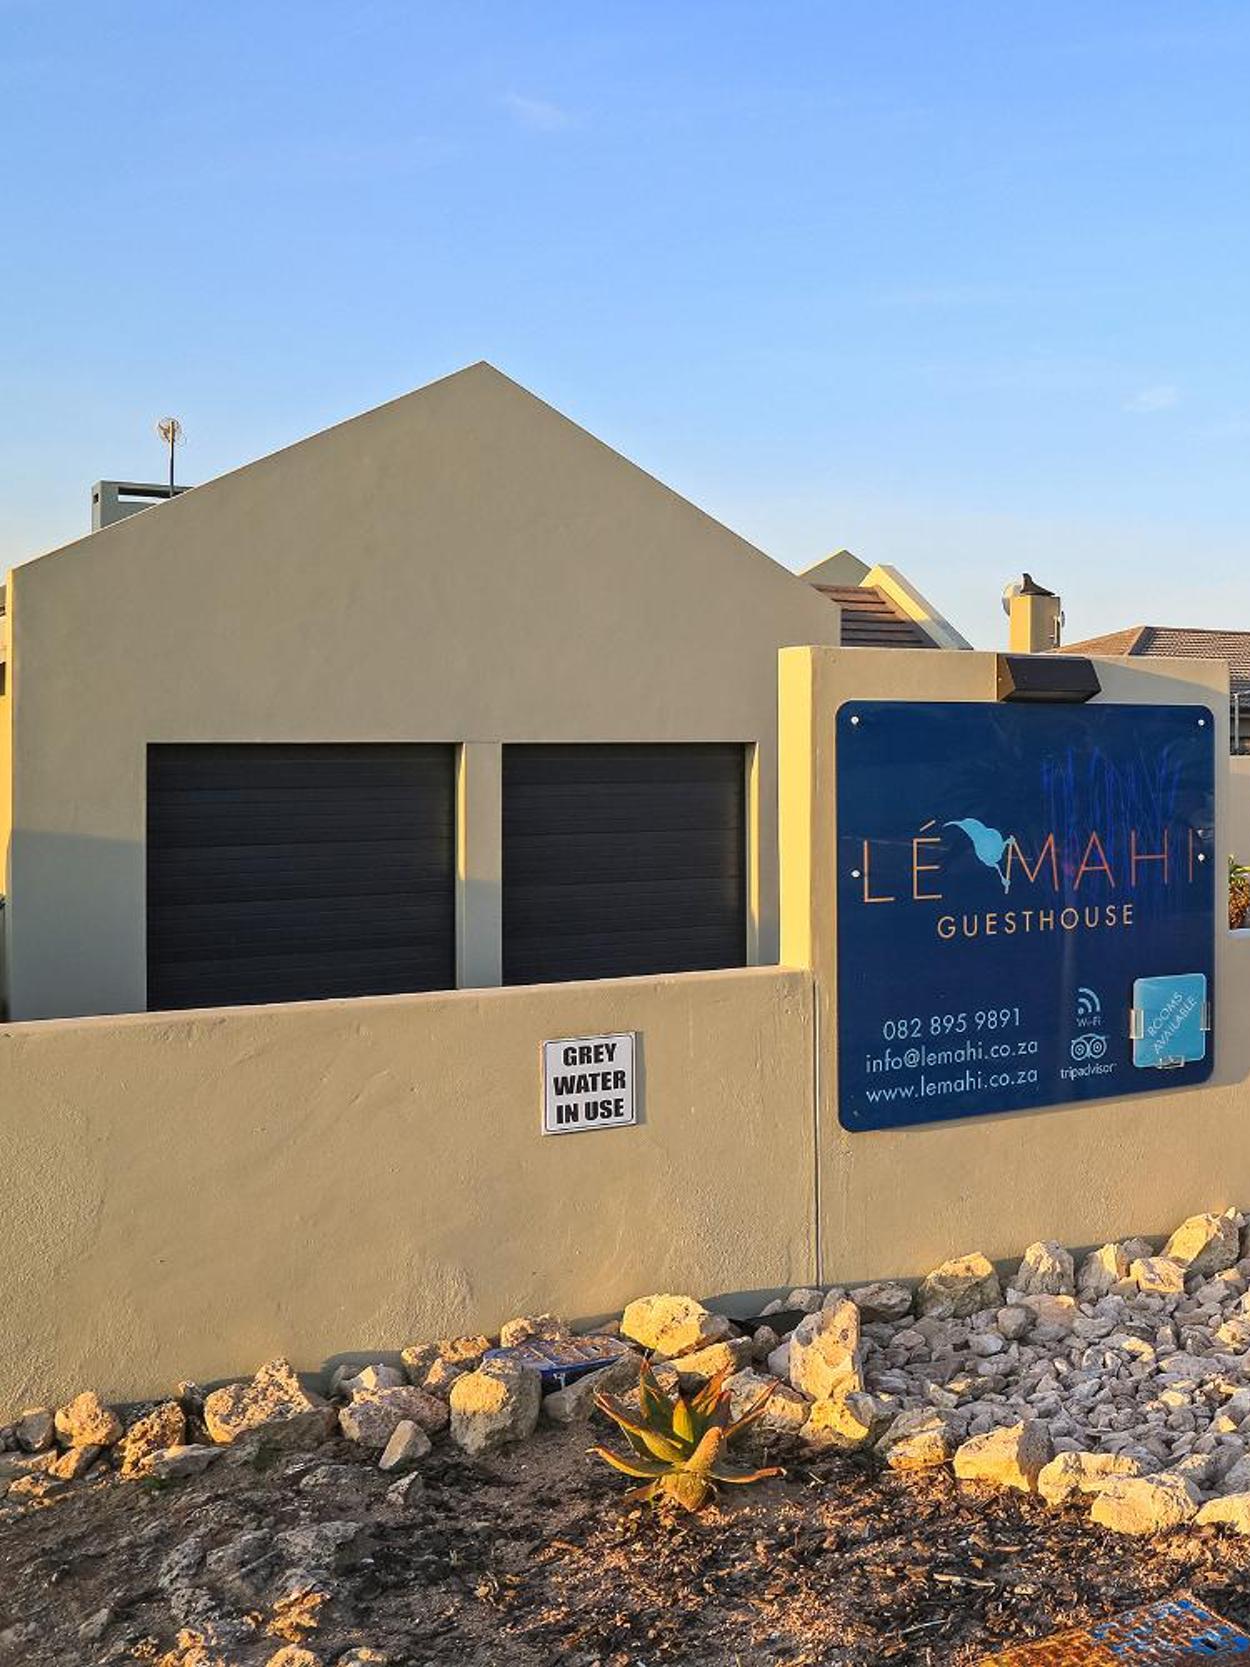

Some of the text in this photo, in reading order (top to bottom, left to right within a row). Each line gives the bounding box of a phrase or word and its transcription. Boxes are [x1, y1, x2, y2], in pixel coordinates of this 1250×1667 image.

[1004, 830, 1194, 893] MAHI
[937, 904, 1134, 939] GUESTHOUSE
[883, 1007, 1020, 1040] 082 895 9891
[1147, 991, 1184, 1036] ROOMS
[1152, 997, 1199, 1053] AVAILABLE
[563, 1043, 617, 1066] GREY
[866, 1040, 1038, 1073] info@lemahi.co.za
[553, 1070, 626, 1096] WATER
[866, 1069, 1038, 1103] www.lemahi.co.za
[1060, 1063, 1113, 1081] tripadvisor
[556, 1098, 624, 1124] IN USE
